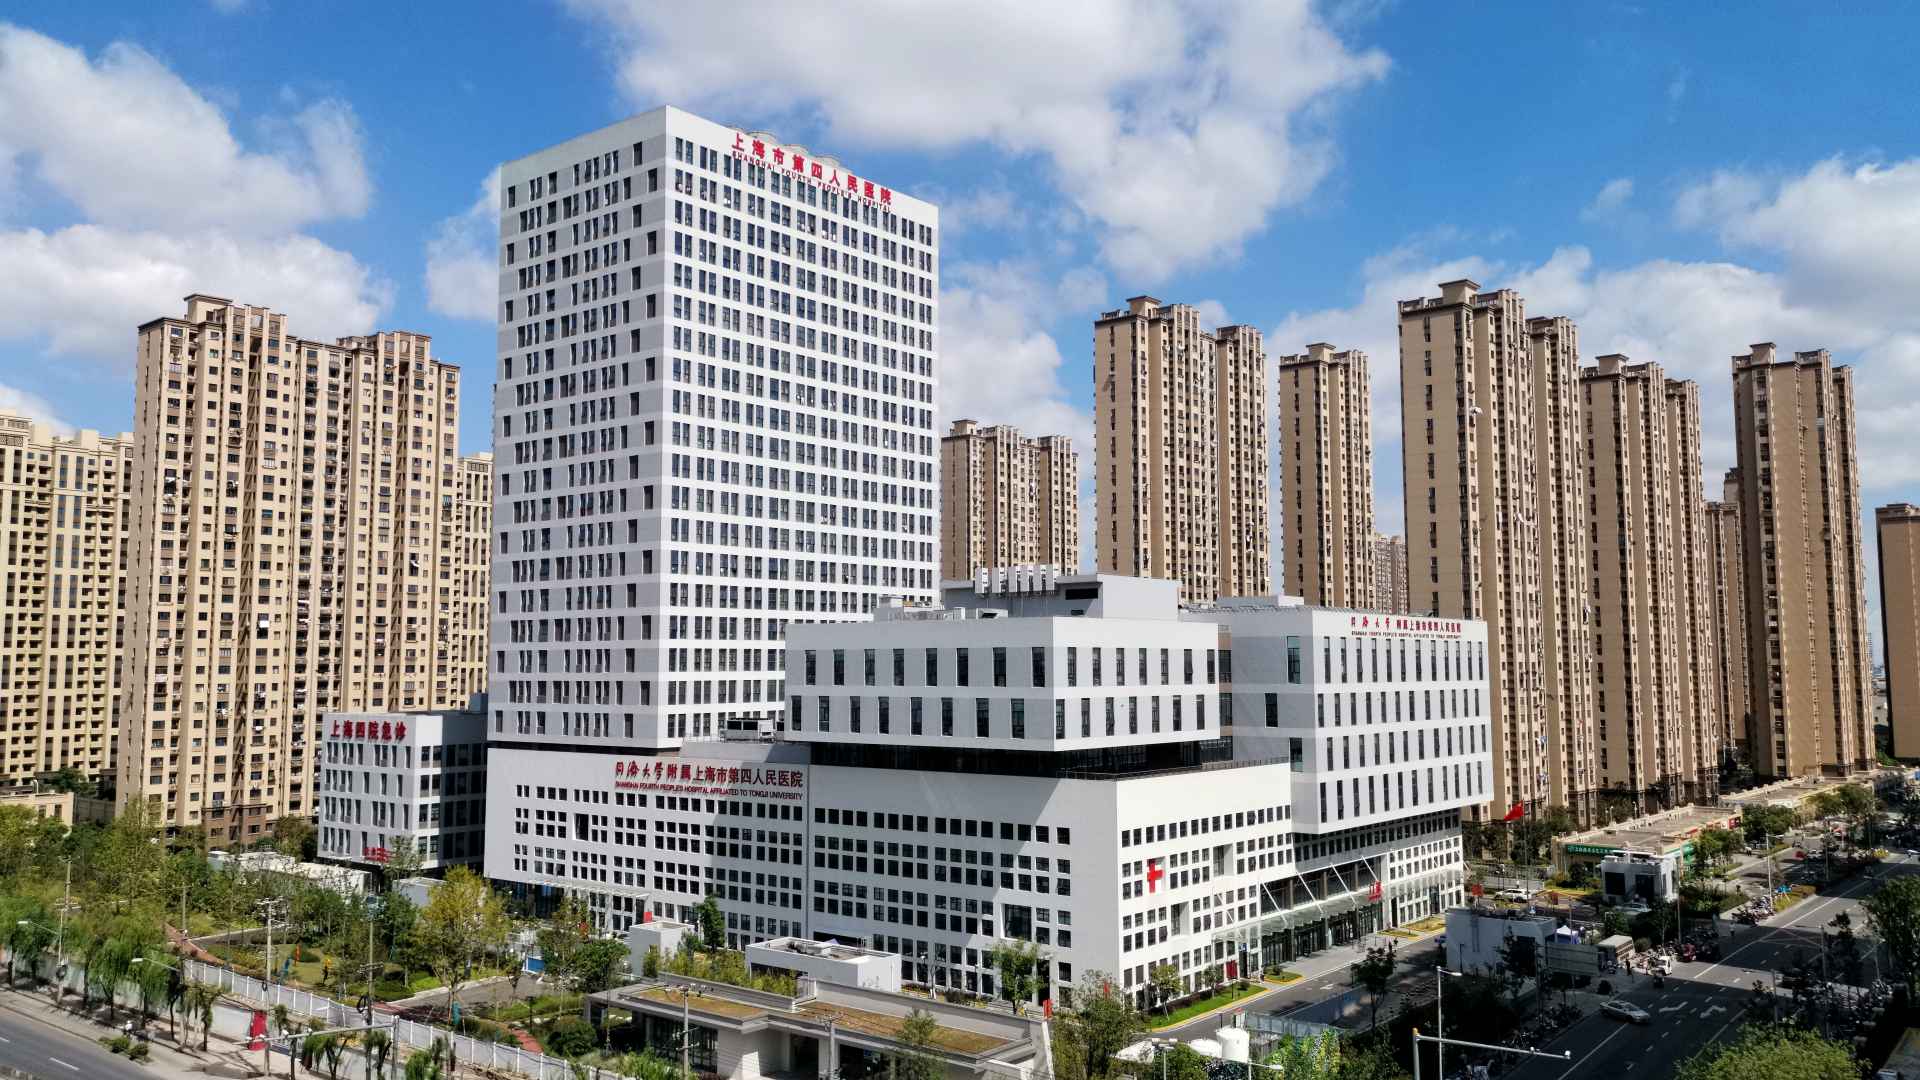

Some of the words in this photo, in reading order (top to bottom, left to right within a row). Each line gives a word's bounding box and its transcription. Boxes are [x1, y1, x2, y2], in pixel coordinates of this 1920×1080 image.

[731, 132, 891, 205] 上海市第四人民医院
[732, 150, 775, 170] SHANGHAI
[781, 167, 812, 183] FOURTH
[857, 196, 891, 211] HOSPITAL
[330, 719, 407, 741] 上海四院急诊
[740, 789, 748, 797] TO
[769, 791, 803, 801] UNIVERSITY
